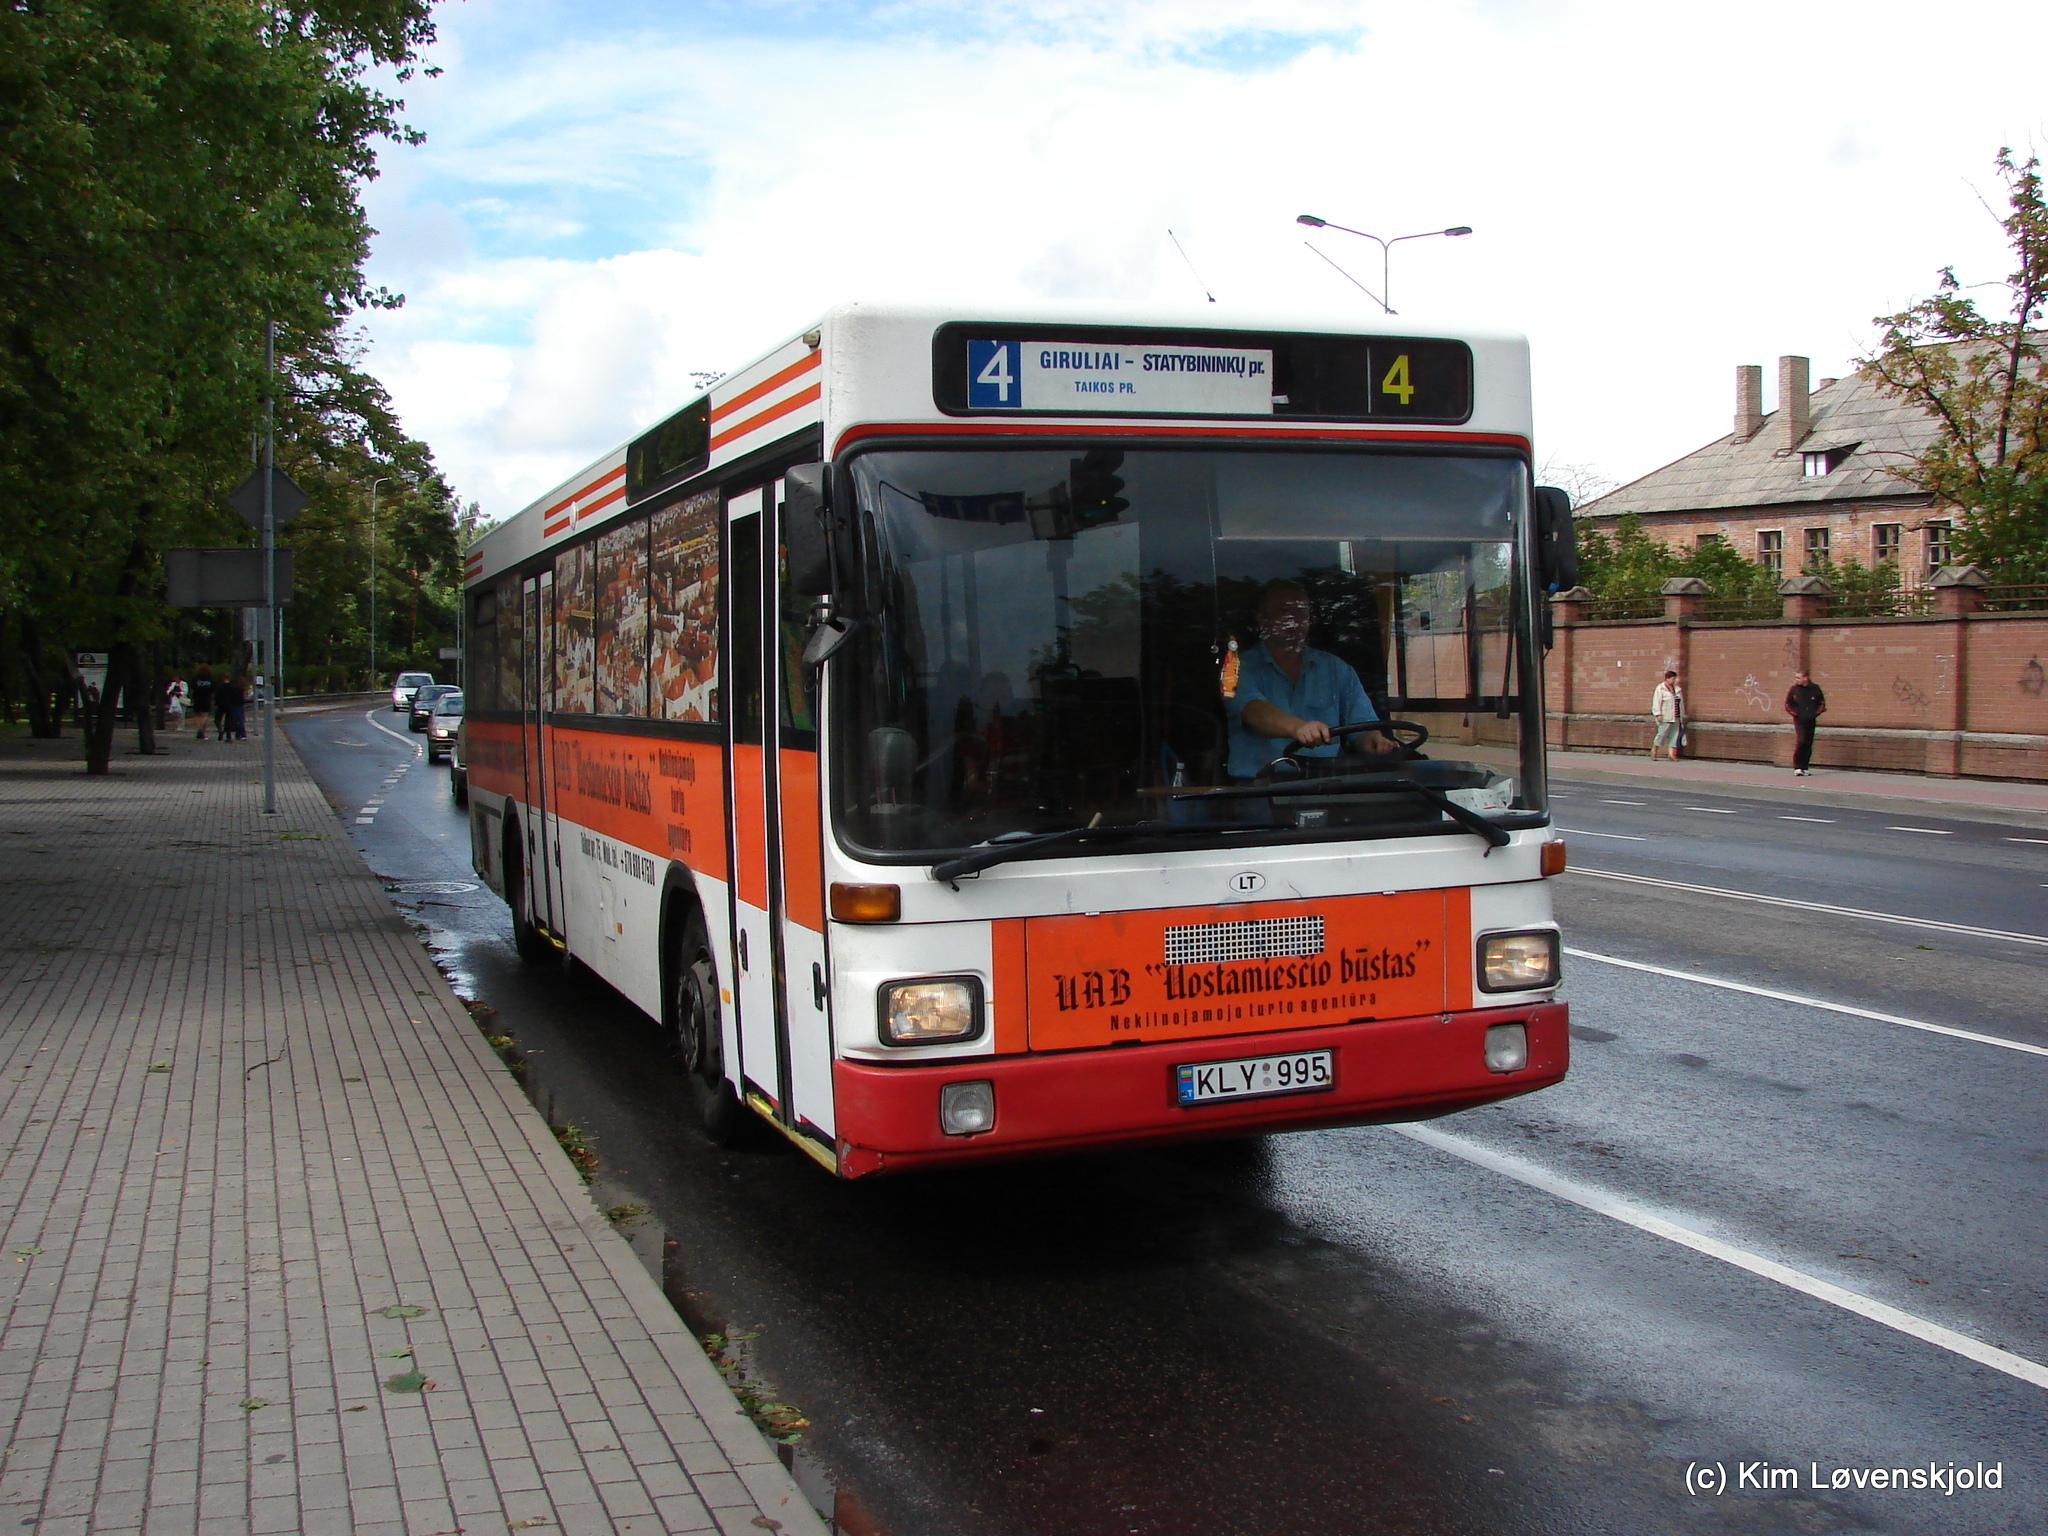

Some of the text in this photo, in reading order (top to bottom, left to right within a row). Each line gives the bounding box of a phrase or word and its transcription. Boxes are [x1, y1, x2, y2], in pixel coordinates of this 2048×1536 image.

[977, 345, 1014, 402] 4
[1040, 351, 1119, 370] GIRULIAI
[1143, 353, 1246, 378] STATYBININKŲ
[1249, 359, 1265, 377] pr.
[1382, 354, 1415, 405] 4
[1075, 381, 1137, 394] TAIKOS PR.
[1239, 876, 1257, 890] LT
[1053, 968, 1132, 1012] UAB
[1111, 993, 1377, 1031] Nekilnojamojo turto agentūra
[1197, 1055, 1326, 1096] KLY 995
